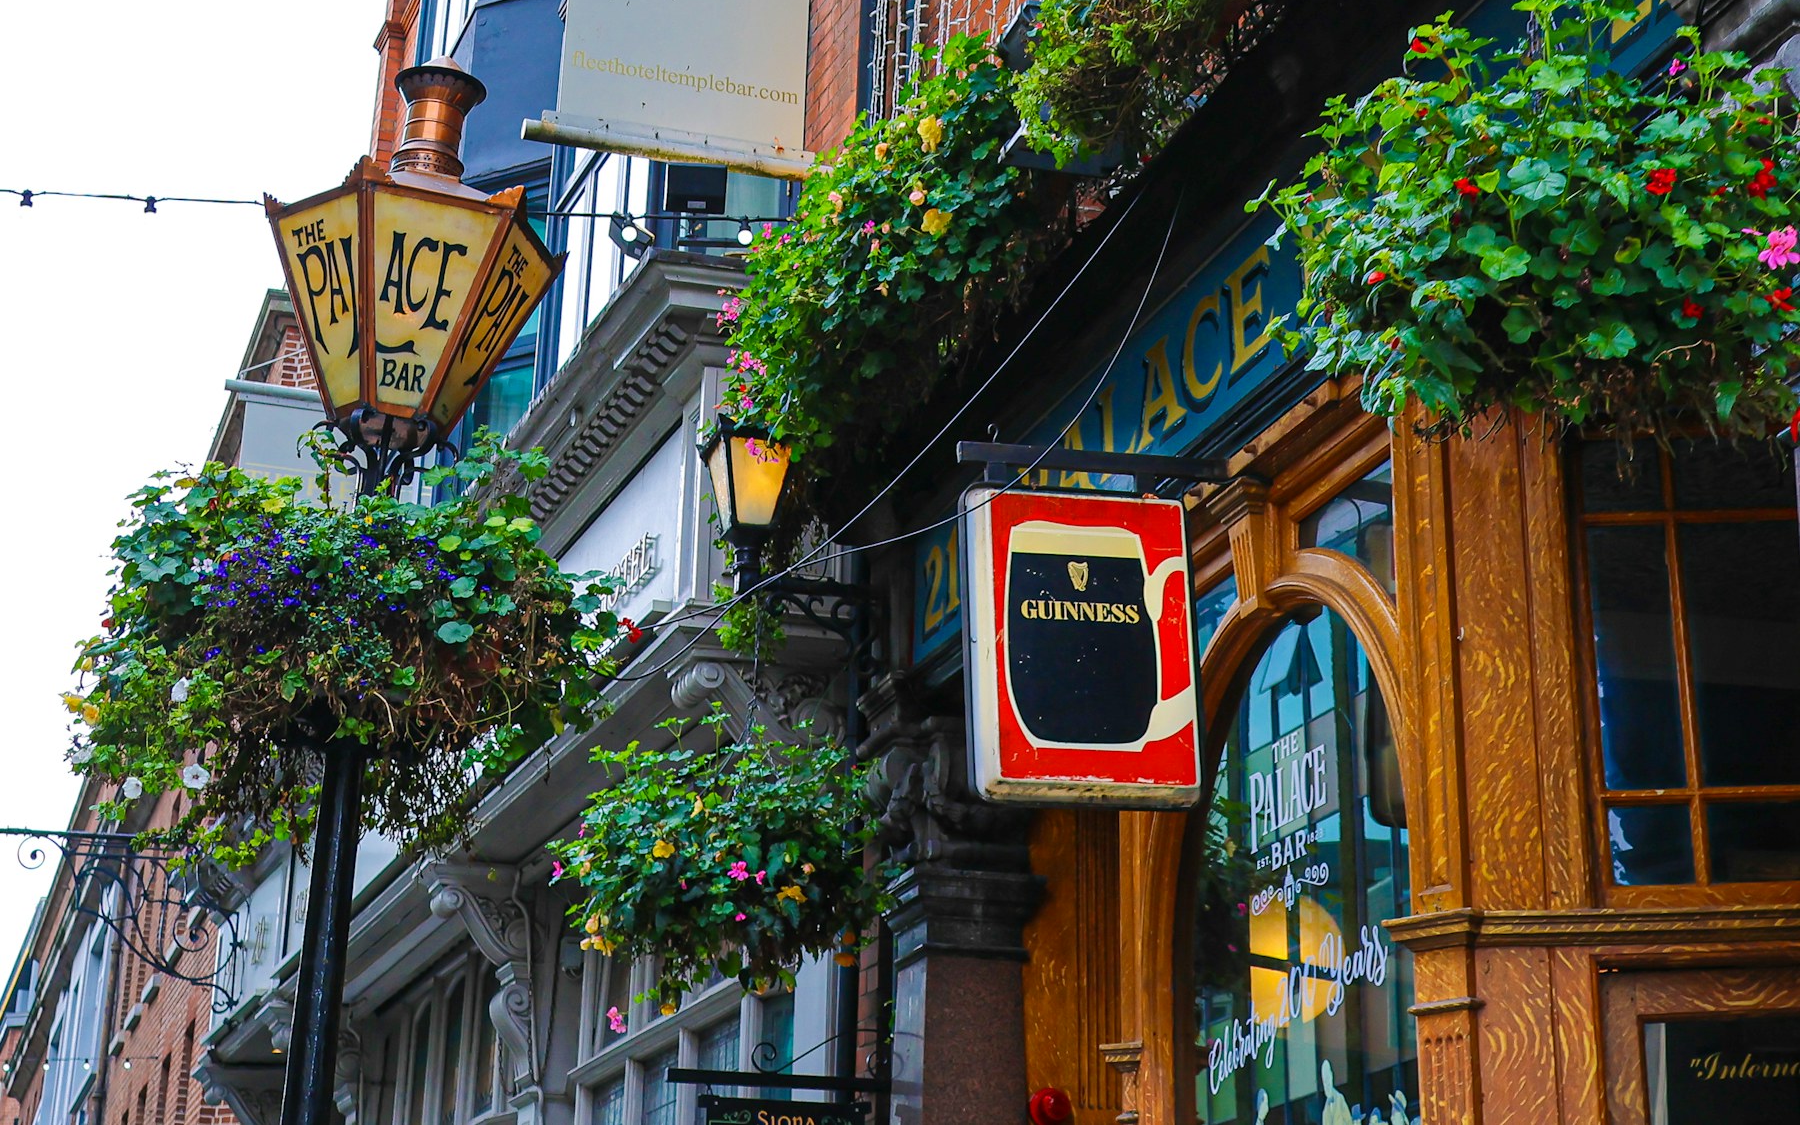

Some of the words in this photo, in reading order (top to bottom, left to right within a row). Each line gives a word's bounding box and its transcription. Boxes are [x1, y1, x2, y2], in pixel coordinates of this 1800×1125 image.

[572, 50, 799, 105] fleethoteltemplebar.com
[292, 218, 326, 248] THE
[507, 243, 529, 280] THE
[378, 358, 425, 394] BAR
[1017, 243, 1275, 489] ALACE
[599, 531, 652, 612] OTEL
[1020, 598, 1141, 625] GUINNESS
[1272, 731, 1300, 764] THE
[1249, 743, 1327, 855] PALACE
[1256, 855, 1272, 871] EST.
[1271, 829, 1308, 872] BAR
[1208, 1001, 1278, 1095] Celebrating
[1277, 955, 1317, 1028] 200
[1319, 925, 1389, 1017] Years
